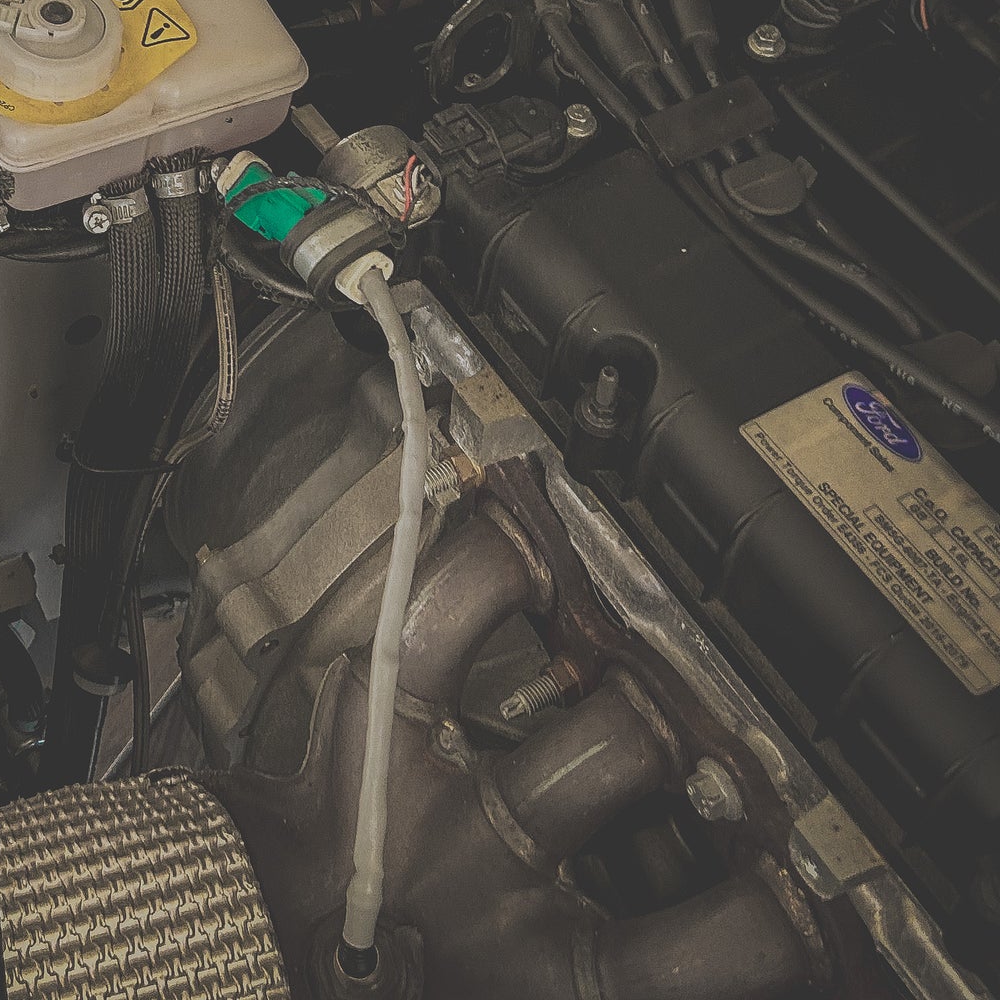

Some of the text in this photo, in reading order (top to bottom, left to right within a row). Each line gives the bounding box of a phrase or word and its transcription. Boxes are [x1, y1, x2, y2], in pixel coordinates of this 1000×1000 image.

[820, 396, 896, 473] Component Sales
[854, 399, 908, 447] Ford
[753, 431, 784, 461] Power
[779, 461, 815, 496] Torque
[810, 494, 841, 524] Order
[868, 559, 894, 583] FCS
[816, 480, 936, 606] SPECIAL EQUIPMENT
[923, 547, 965, 587] BUILD
